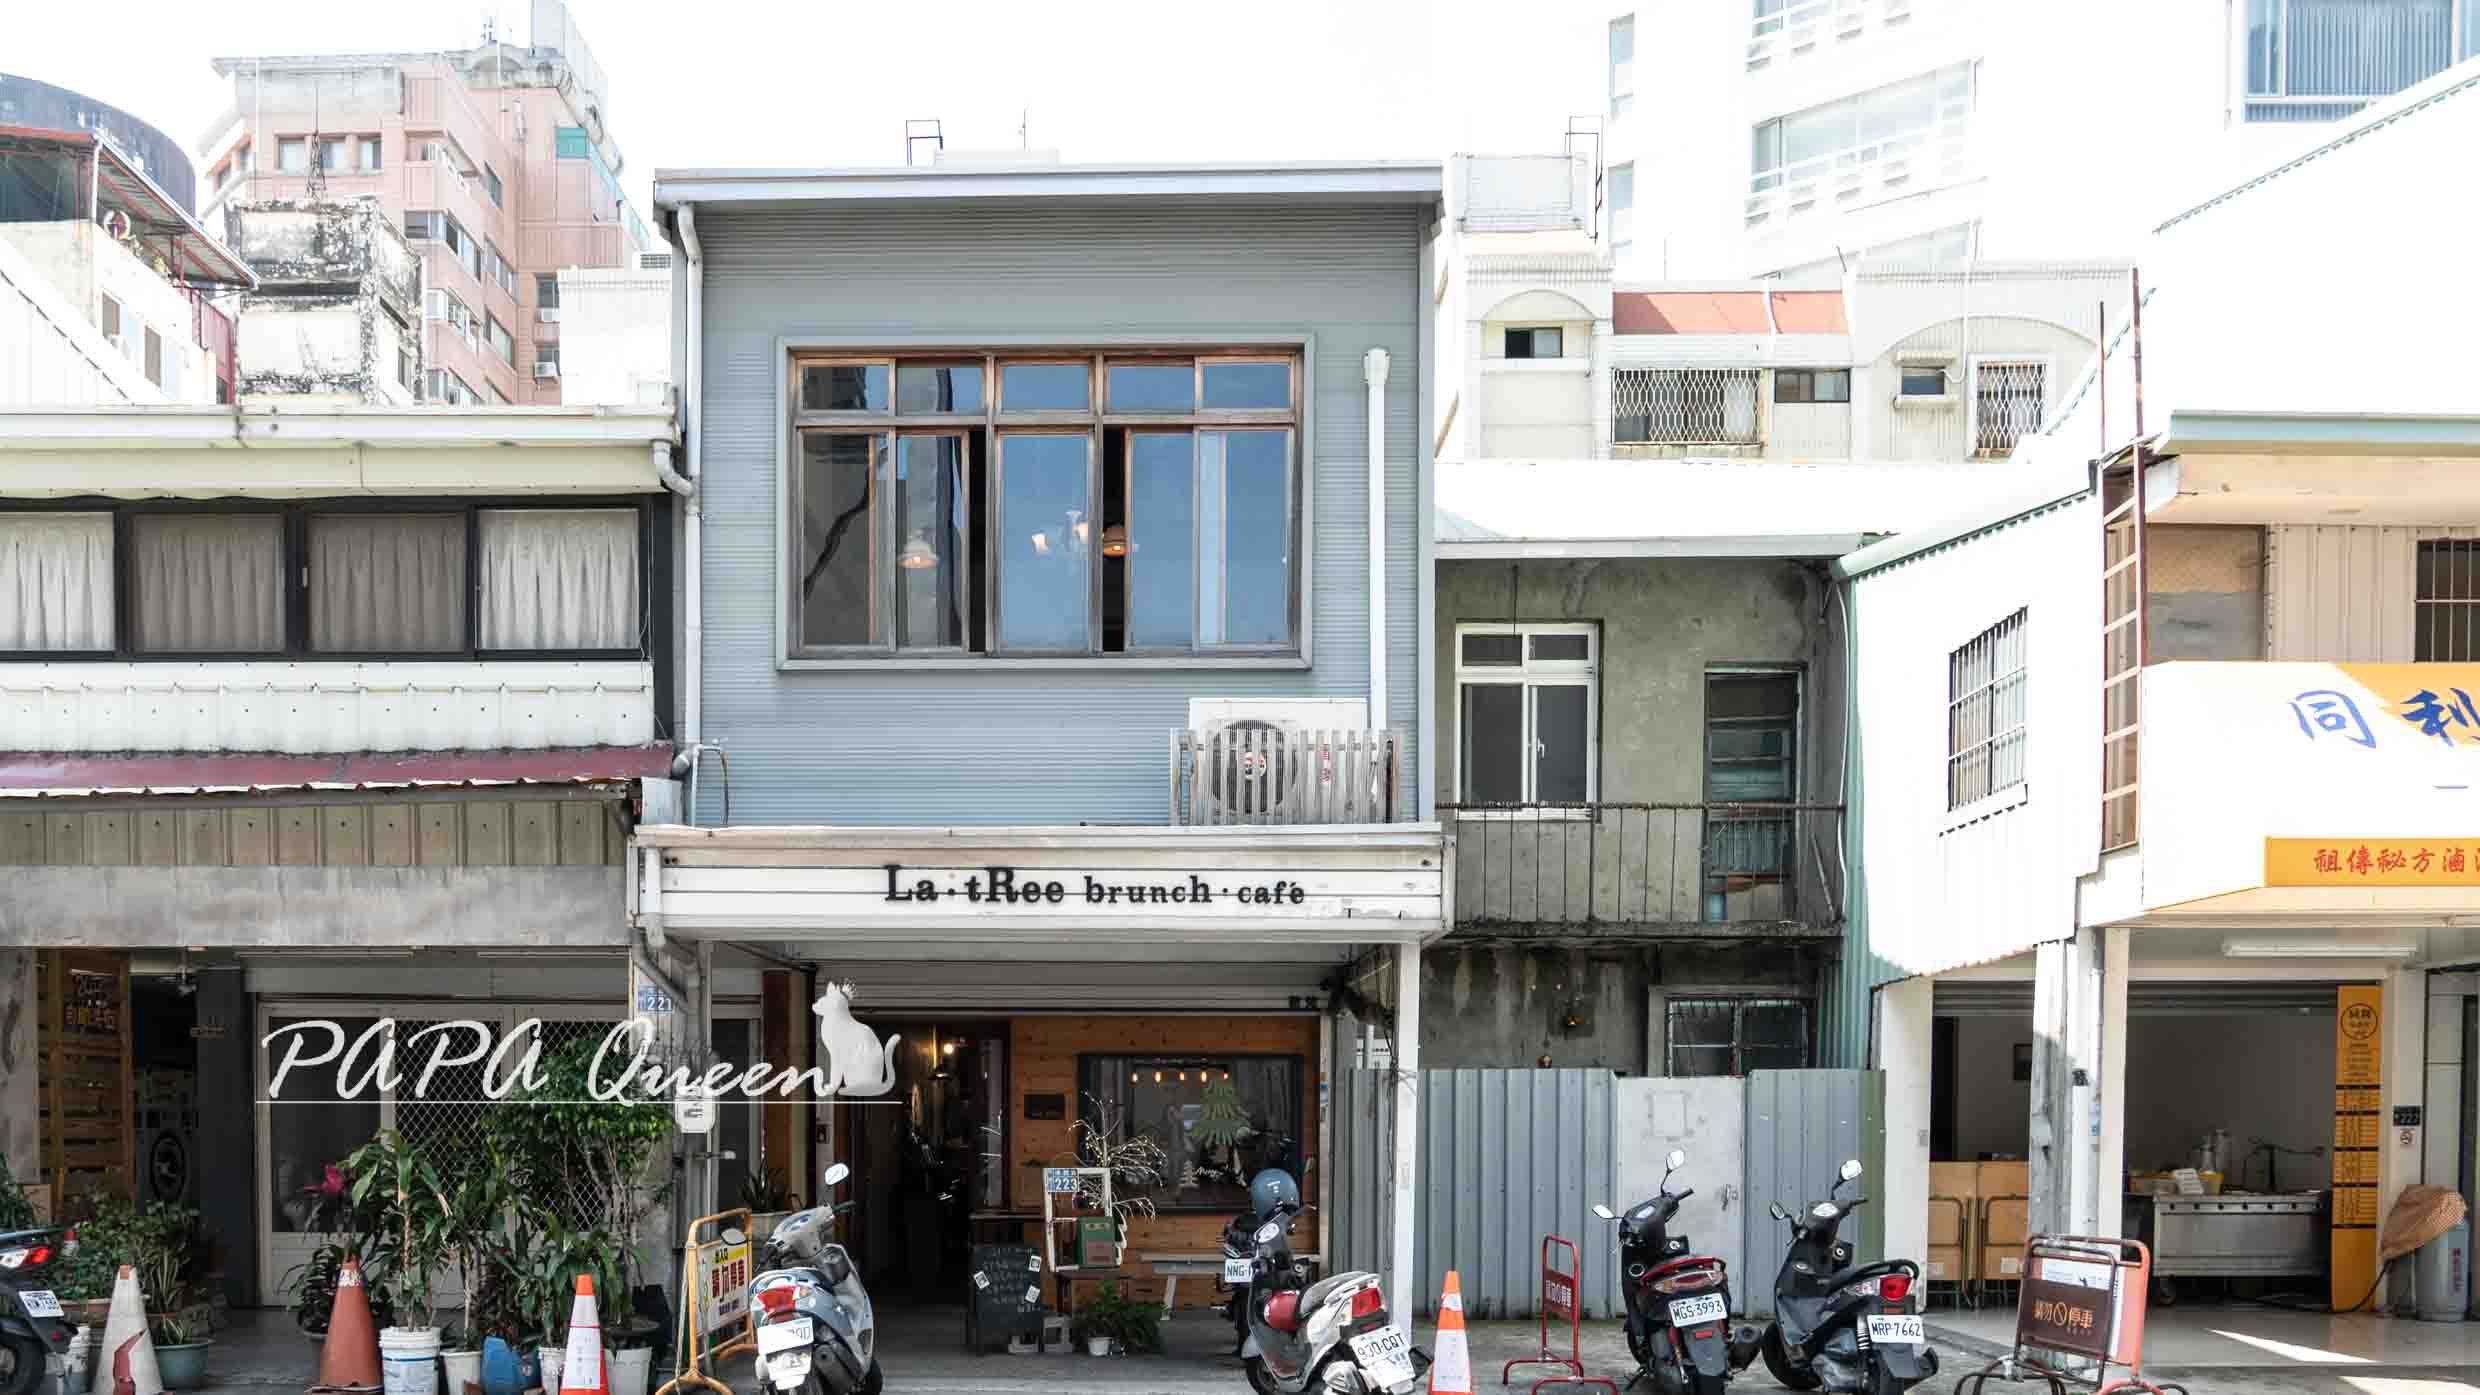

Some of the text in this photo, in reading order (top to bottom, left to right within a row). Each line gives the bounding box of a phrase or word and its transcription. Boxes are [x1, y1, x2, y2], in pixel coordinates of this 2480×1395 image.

[2288, 687, 2480, 749] 同利
[647, 996, 672, 1011] 221
[1054, 1178, 1078, 1190] 223
[1673, 1300, 1723, 1320] MGS-3993
[1871, 1322, 1921, 1337] MRP-7662
